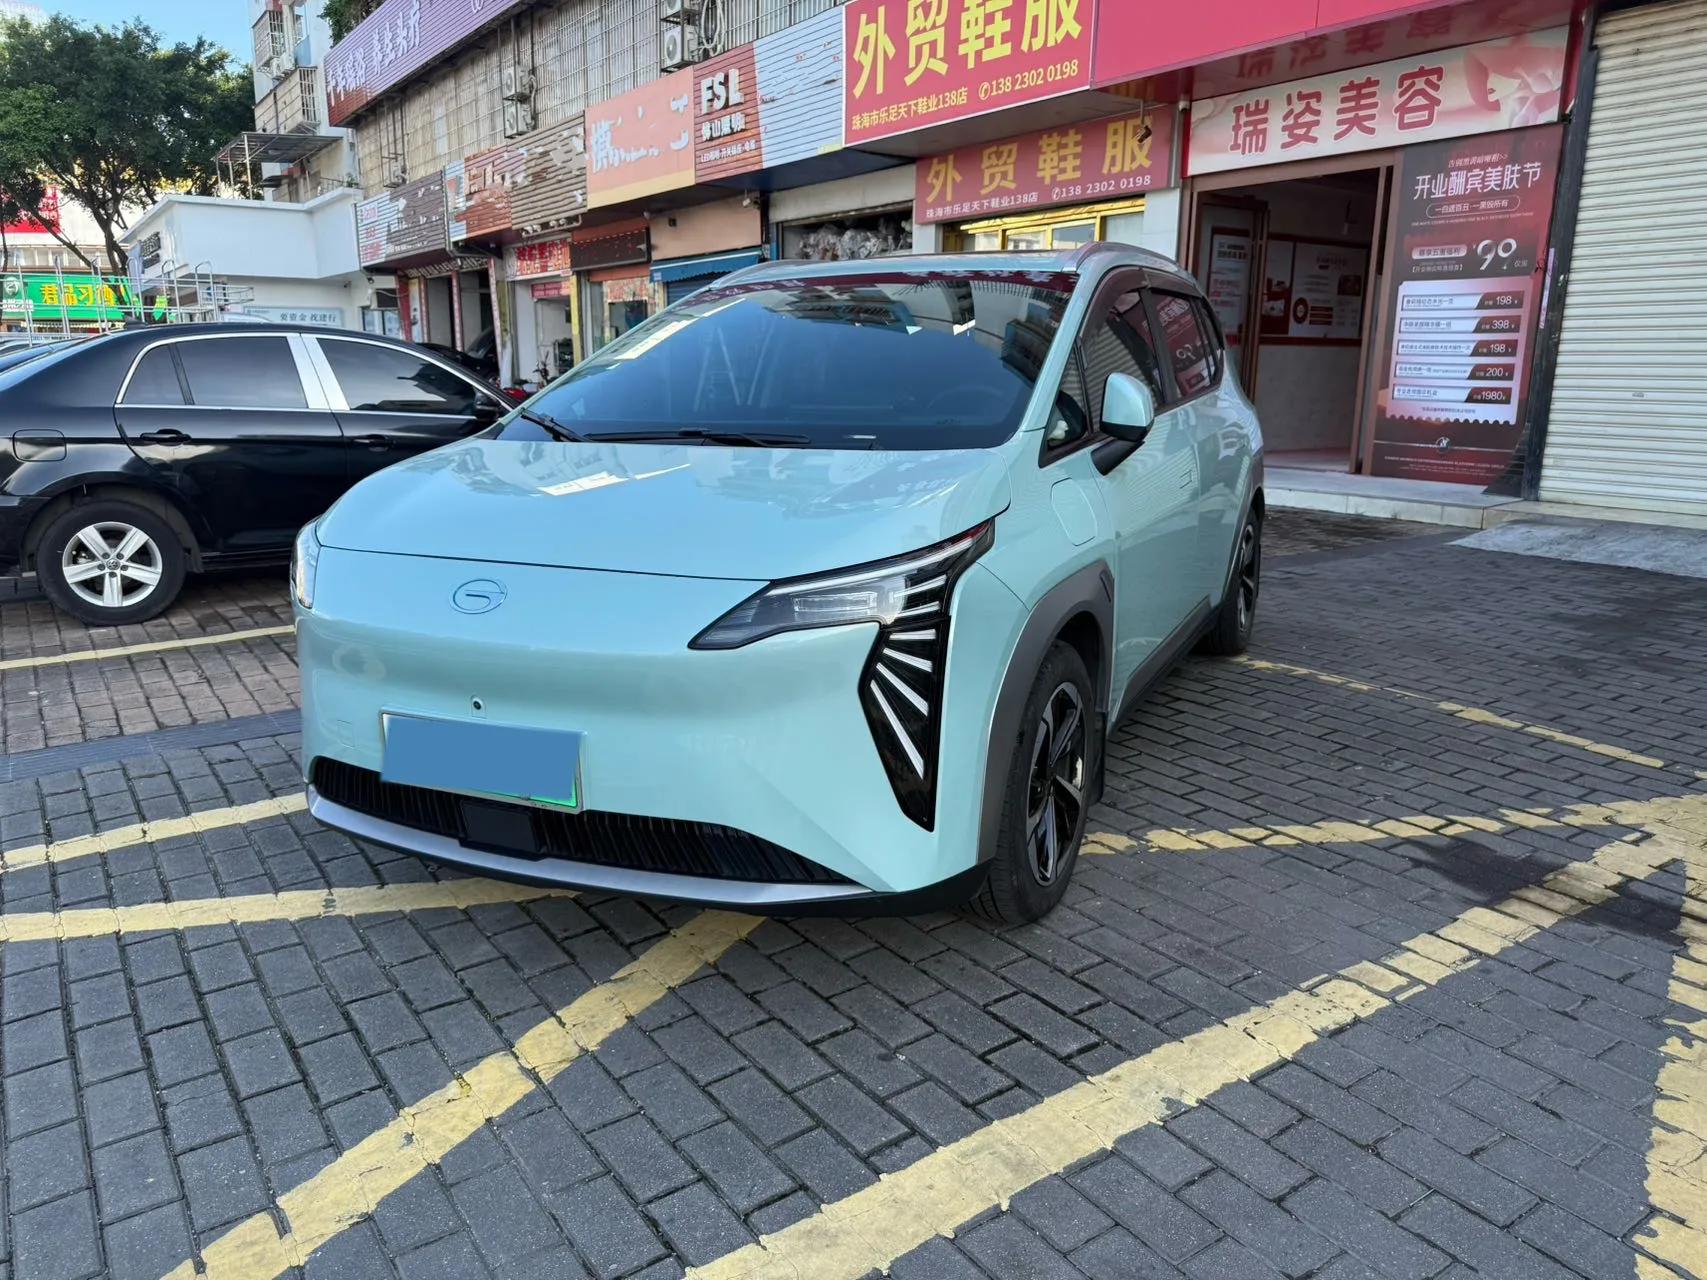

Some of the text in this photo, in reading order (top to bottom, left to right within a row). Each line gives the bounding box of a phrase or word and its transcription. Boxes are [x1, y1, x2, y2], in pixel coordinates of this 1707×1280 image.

[852, 0, 1082, 99] 外贸鞋服
[701, 68, 745, 114] FSL
[990, 59, 1079, 97] 138 2302 0198
[851, 87, 968, 130] 珠海市乐足天下鞋业138店
[1229, 66, 1444, 155] 瑞姿美容
[926, 116, 1154, 204] 外贸鞋服
[1061, 174, 1152, 198] 138 2302 0198
[1413, 161, 1543, 200] 开业酬宾美肤节
[925, 191, 1039, 218] 珠海市乐足天下鞋业138店
[1496, 295, 1512, 306] 198
[1491, 320, 1510, 330] 398
[1490, 343, 1506, 353] 198
[1486, 367, 1504, 377] 200
[1481, 391, 1503, 401] 1980
